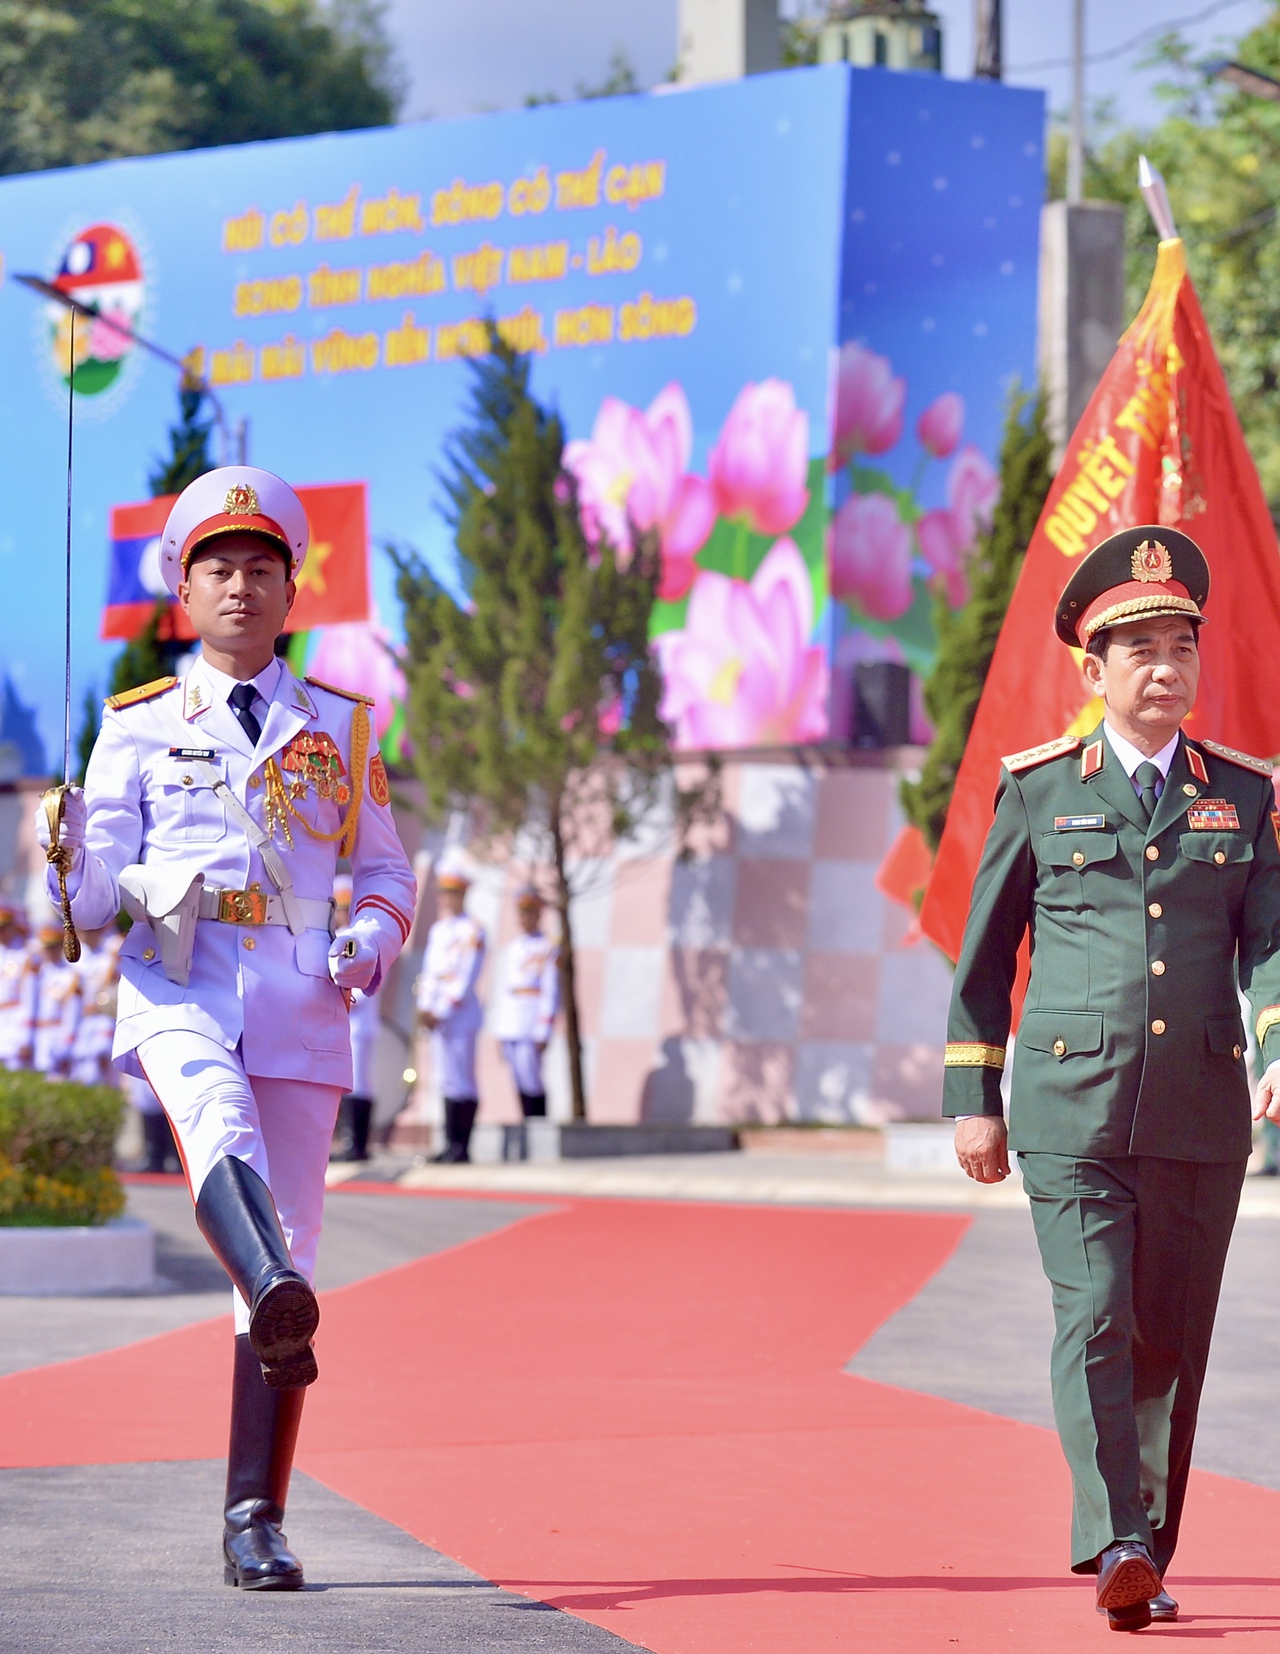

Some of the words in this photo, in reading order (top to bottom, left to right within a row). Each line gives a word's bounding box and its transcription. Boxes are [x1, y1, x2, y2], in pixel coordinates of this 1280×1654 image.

[270, 203, 308, 246] CÓ
[509, 169, 550, 215] CÓ
[454, 243, 504, 294] VIỆT
[508, 242, 567, 282] NAM
[588, 227, 640, 275] LÀO
[1043, 438, 1136, 557] QUYẾT
